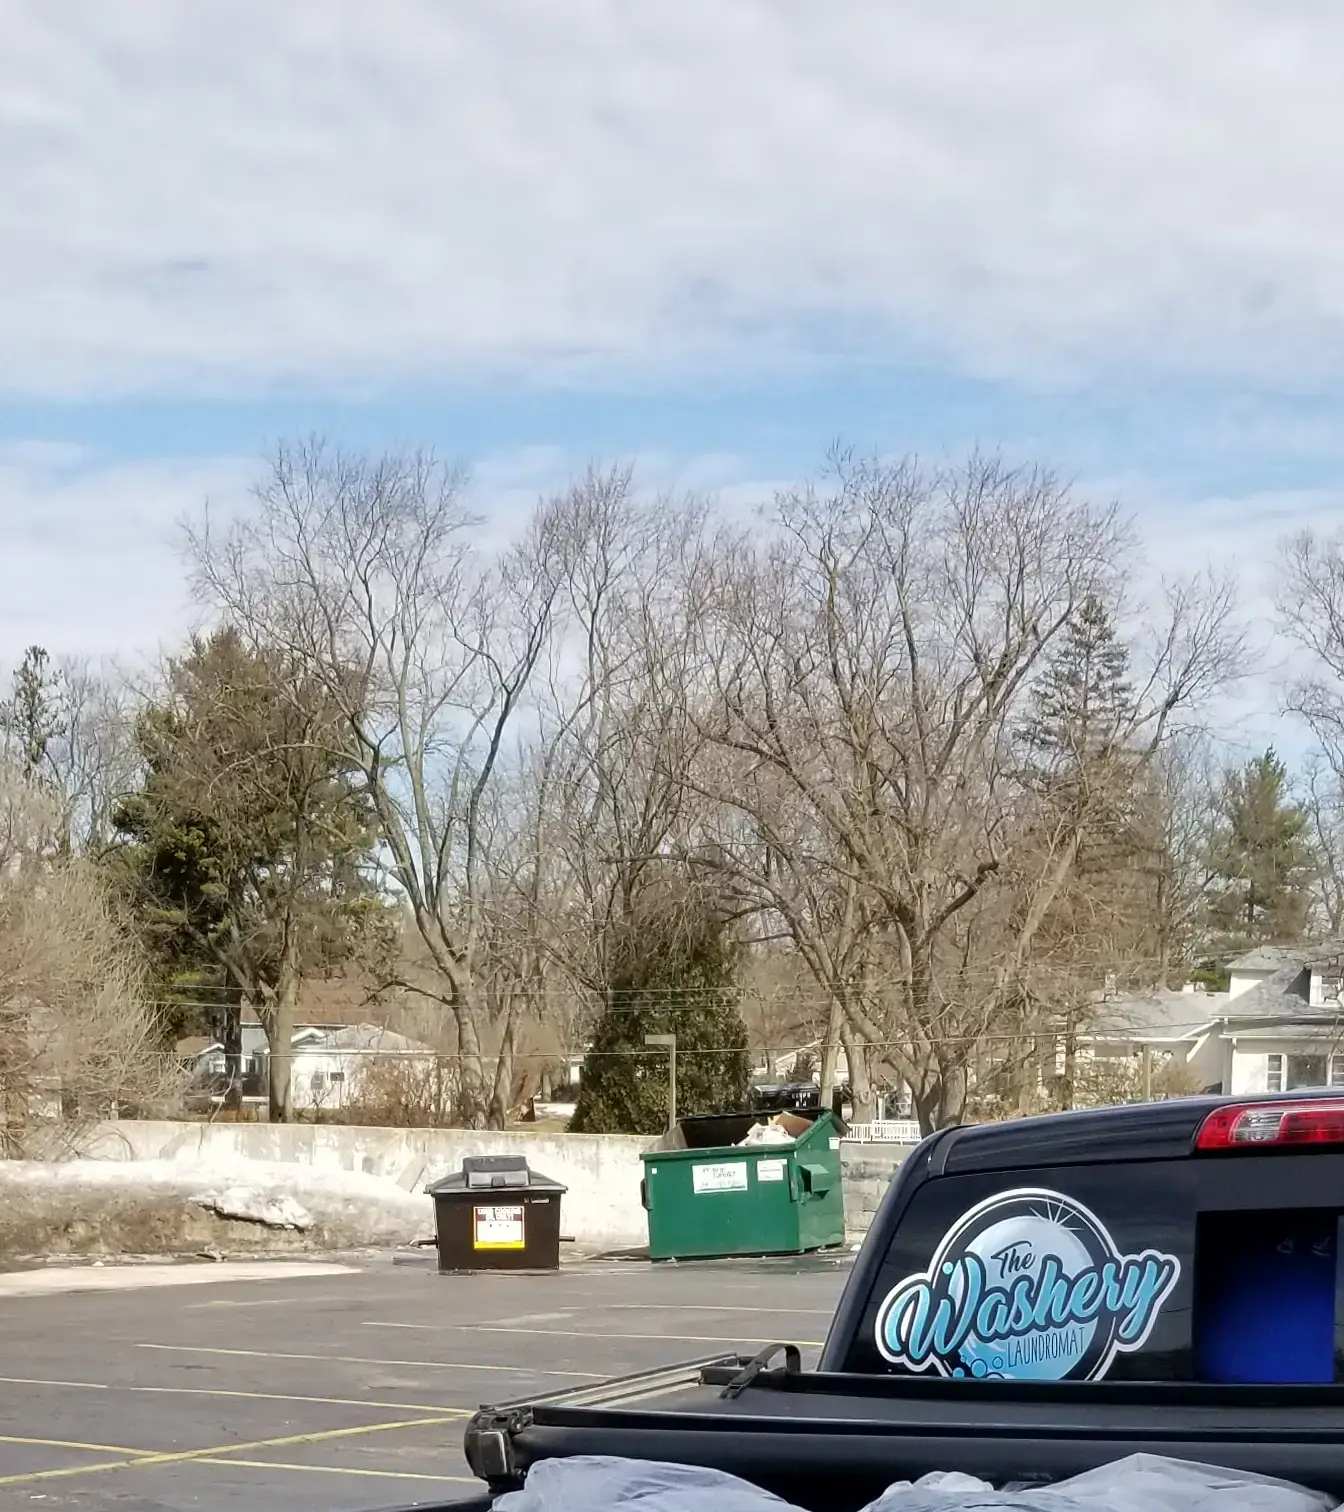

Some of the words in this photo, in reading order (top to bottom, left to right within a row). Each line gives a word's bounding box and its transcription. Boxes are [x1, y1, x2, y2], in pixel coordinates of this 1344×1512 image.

[991, 1240, 1036, 1279] The
[882, 1251, 1172, 1362] Washery
[1007, 1326, 1085, 1368] LAUNDROMAT
